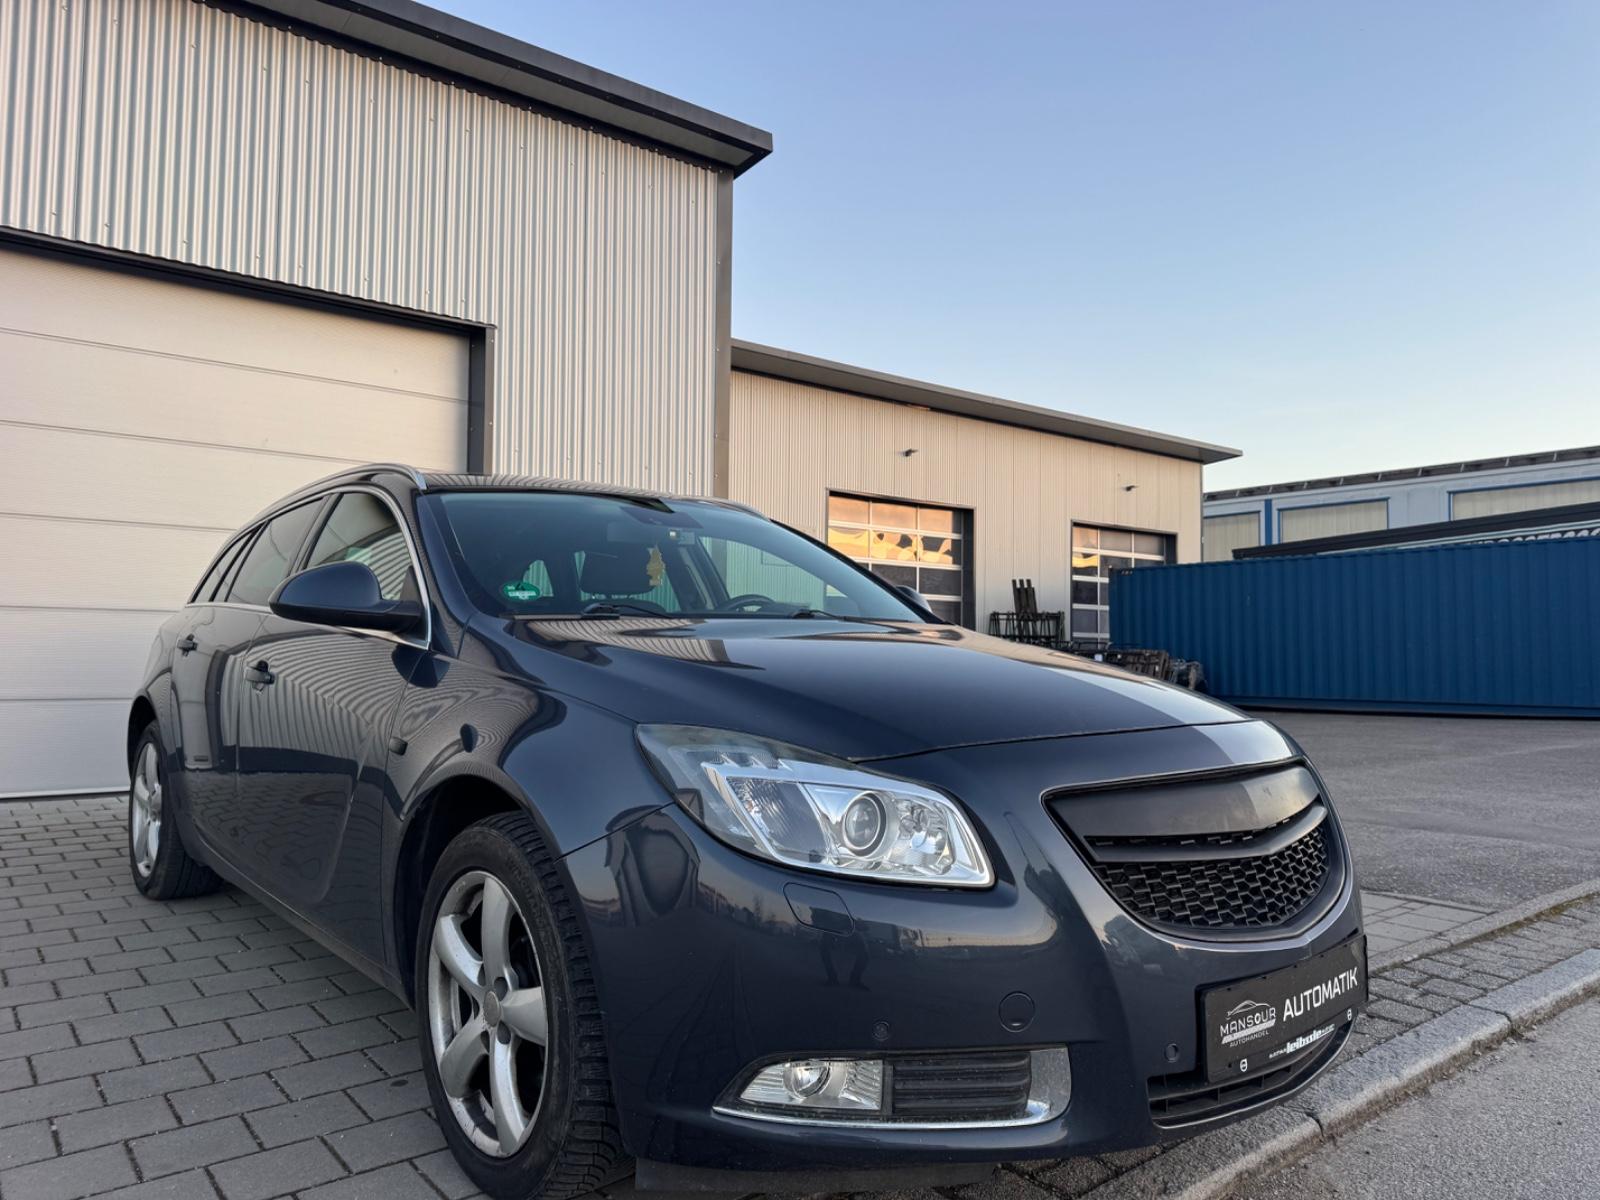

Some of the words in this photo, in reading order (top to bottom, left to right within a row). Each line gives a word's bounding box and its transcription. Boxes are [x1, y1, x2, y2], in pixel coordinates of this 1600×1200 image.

[1283, 967, 1358, 1022] AUTOMATIK
[1220, 1007, 1276, 1037] MANSOUR
[1229, 1030, 1269, 1048] AUTOHANDEL
